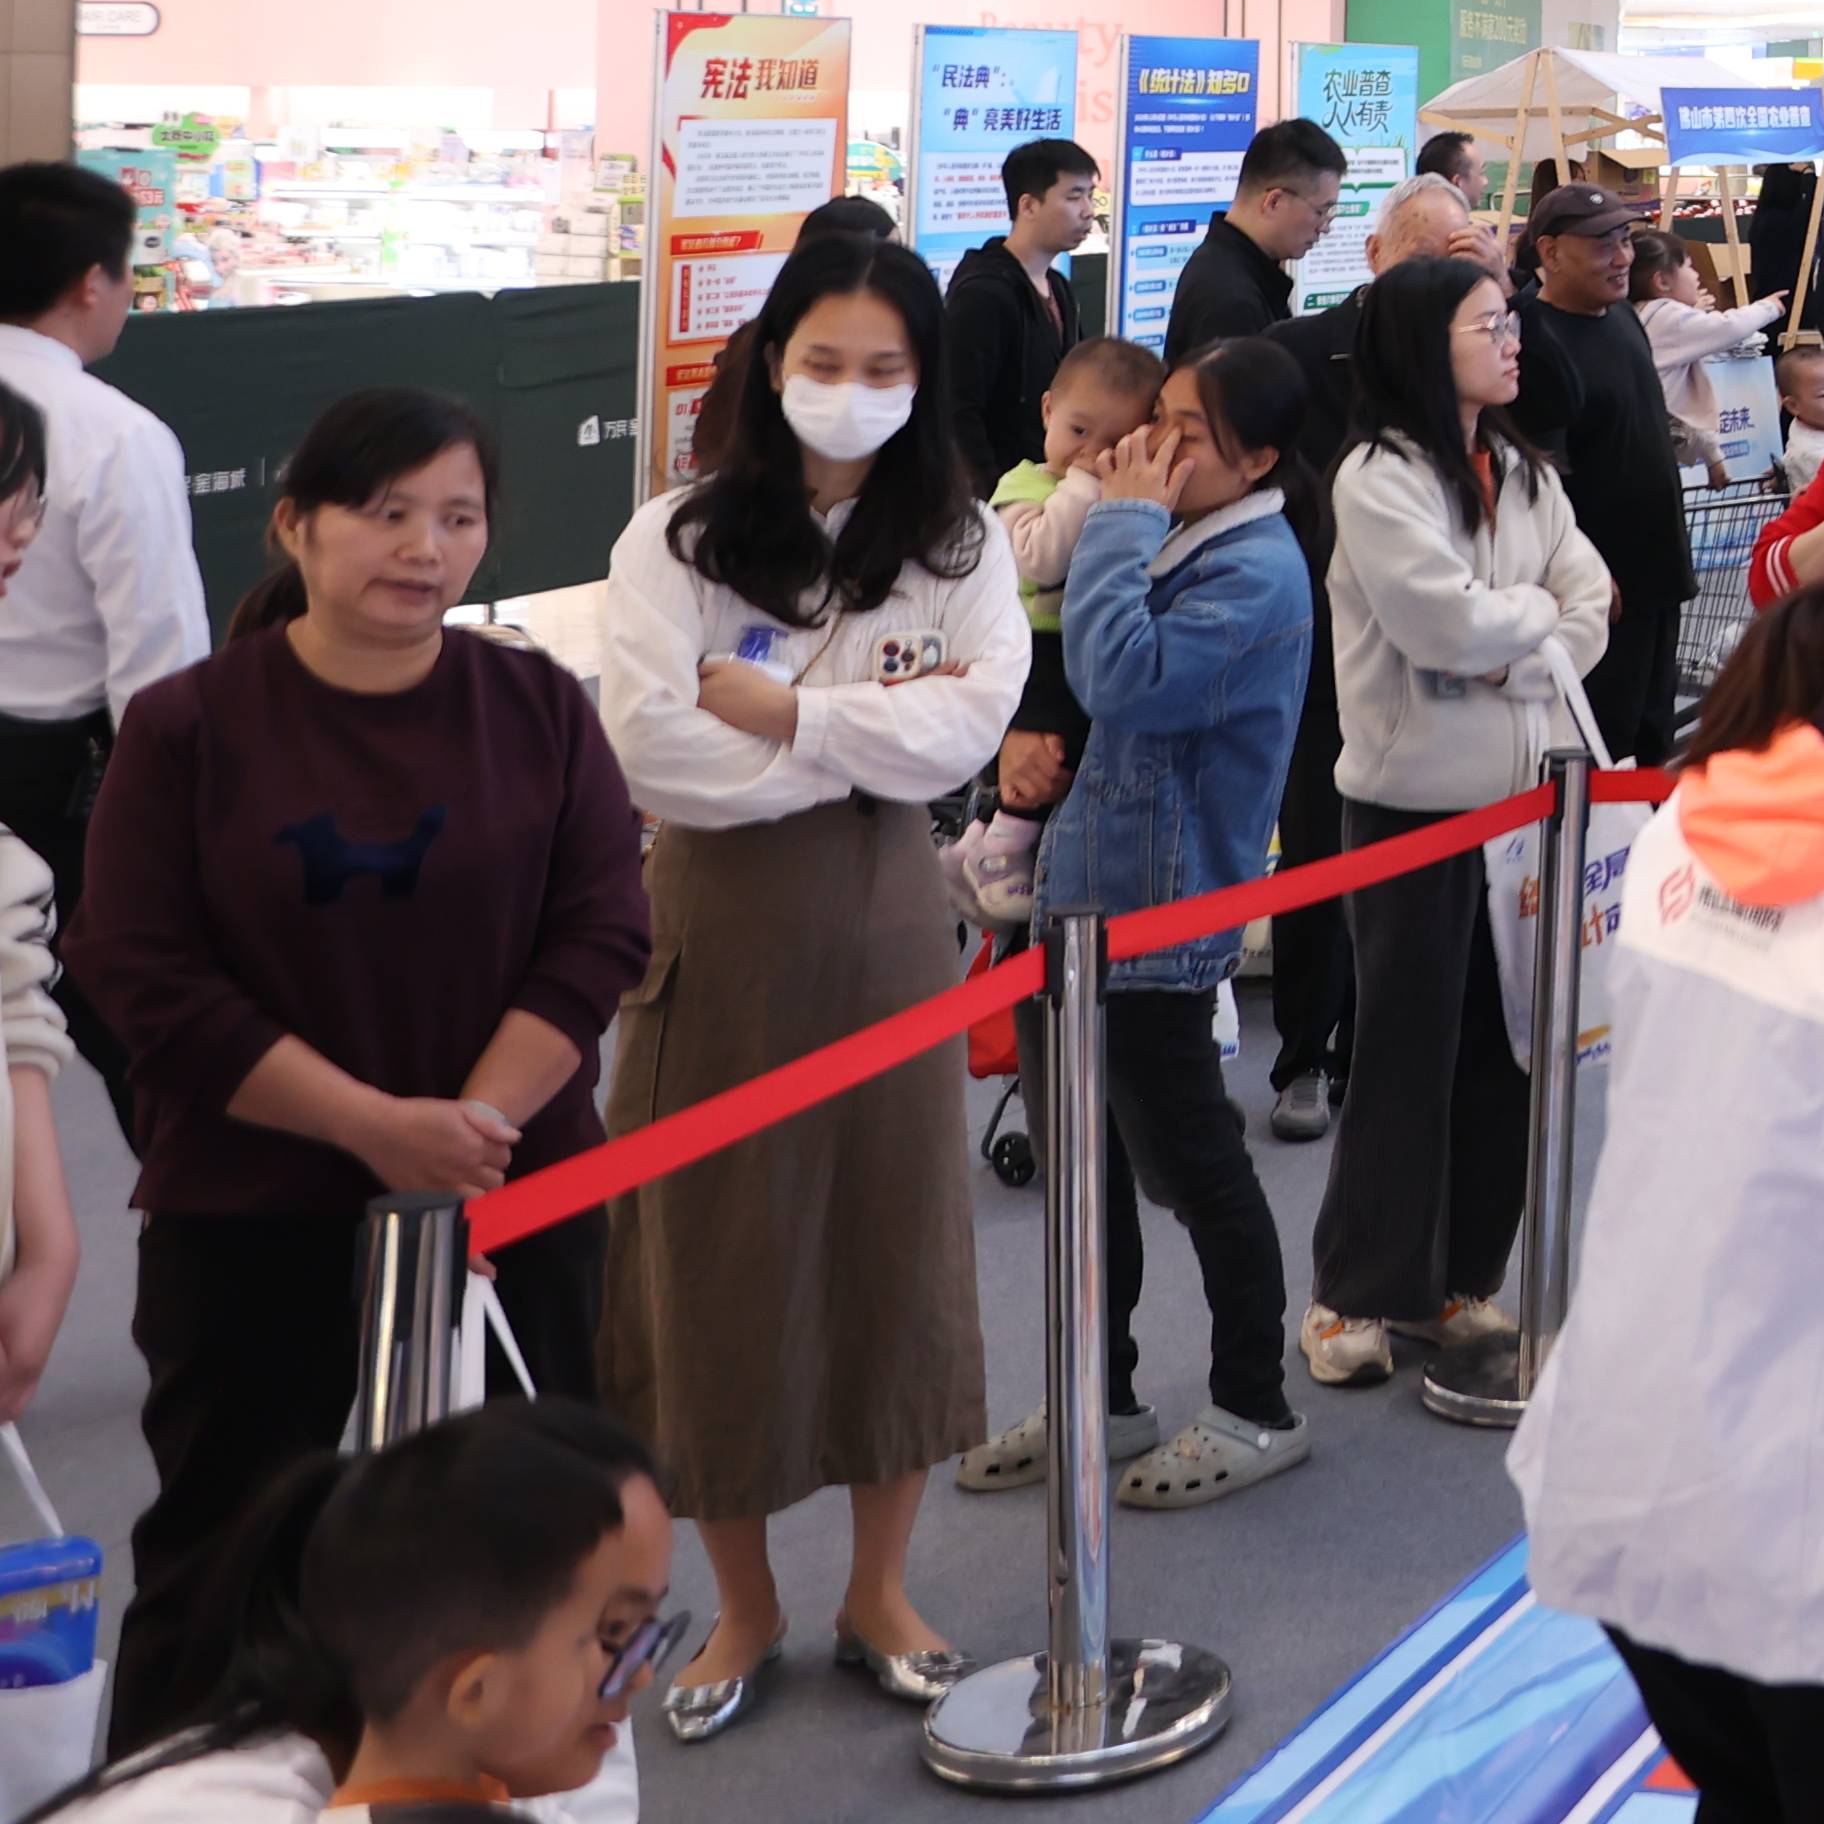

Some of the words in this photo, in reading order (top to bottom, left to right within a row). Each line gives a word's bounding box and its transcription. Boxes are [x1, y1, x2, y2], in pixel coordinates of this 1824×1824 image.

[700, 57, 820, 100] 宪法我知道
[1323, 68, 1394, 104] 农业普查
